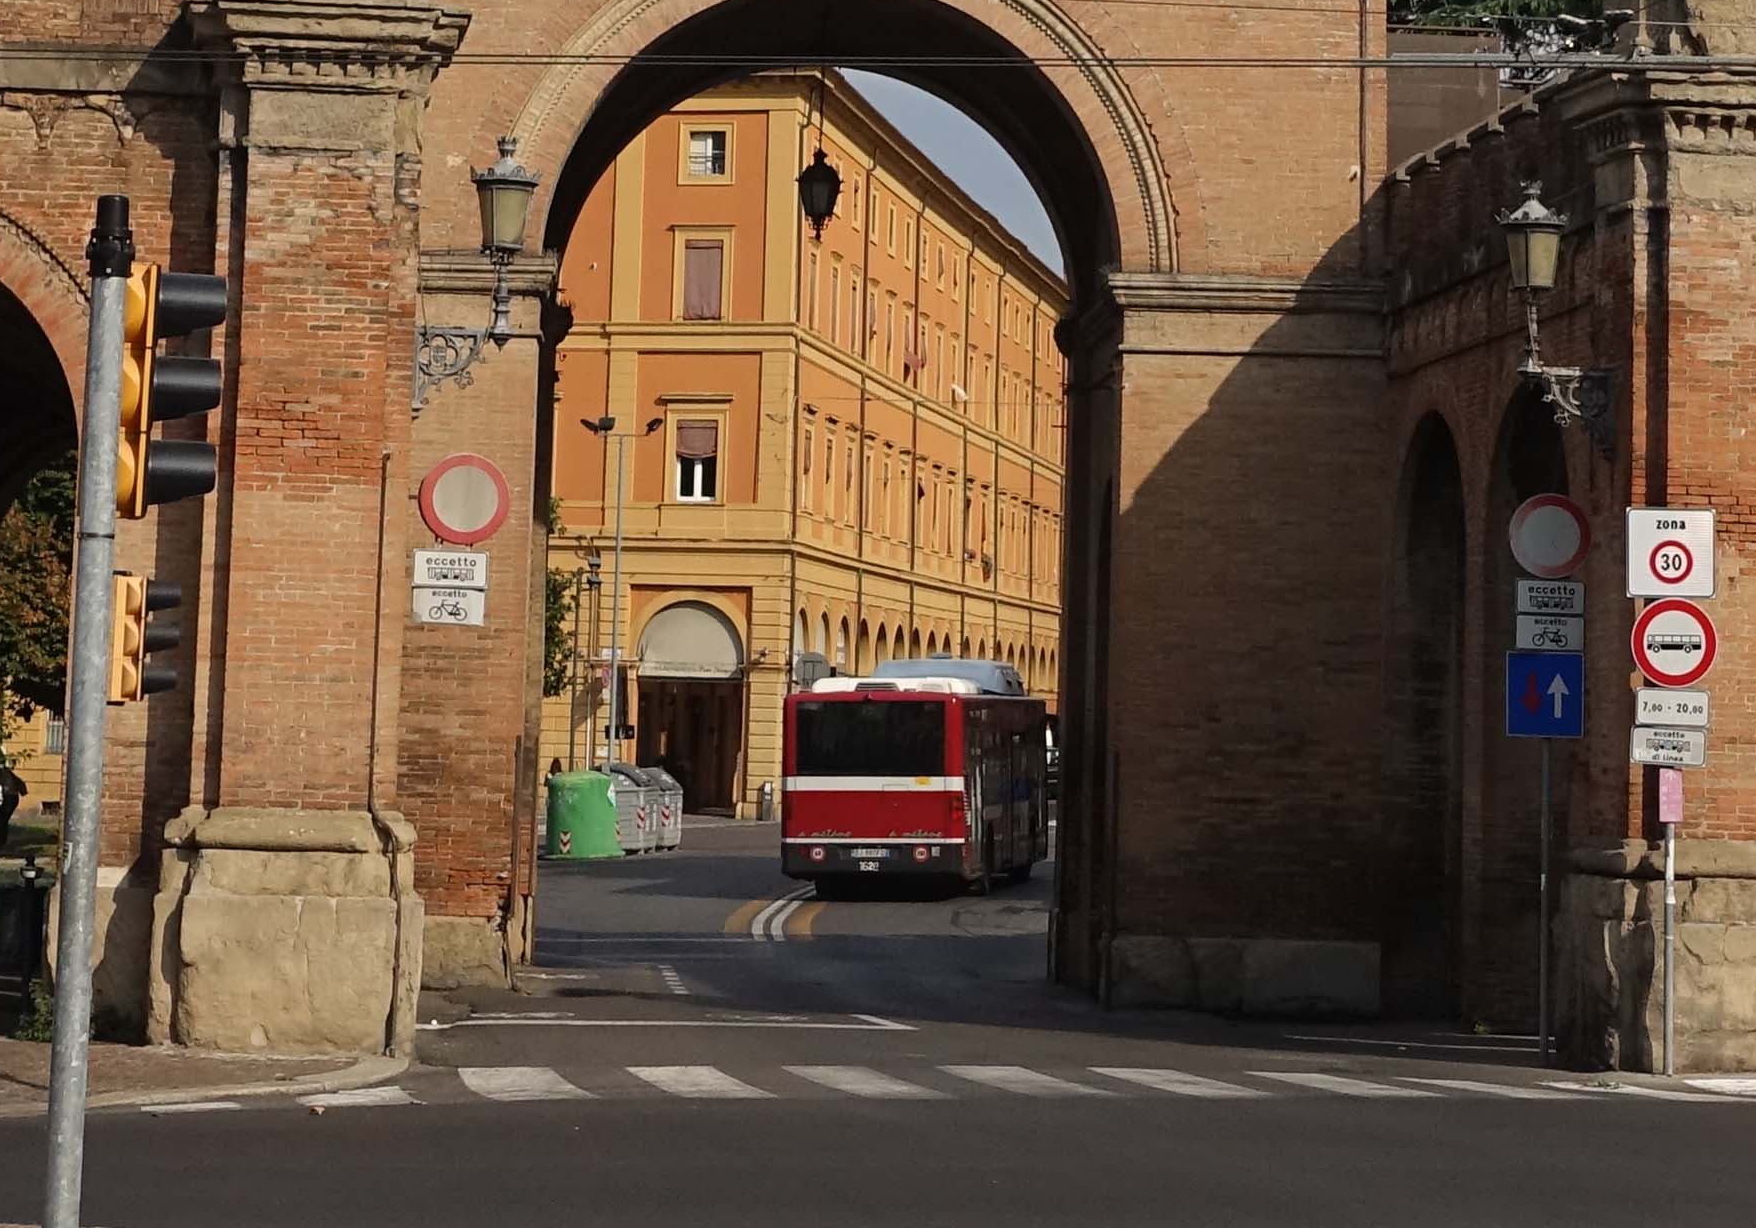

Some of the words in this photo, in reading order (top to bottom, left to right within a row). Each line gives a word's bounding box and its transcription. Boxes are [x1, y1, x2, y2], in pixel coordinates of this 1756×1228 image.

[1656, 520, 1686, 530] zona
[426, 557, 477, 567] eccetto
[1661, 553, 1682, 571] 30
[432, 590, 467, 598] eccetto
[1528, 586, 1575, 596] eccetto
